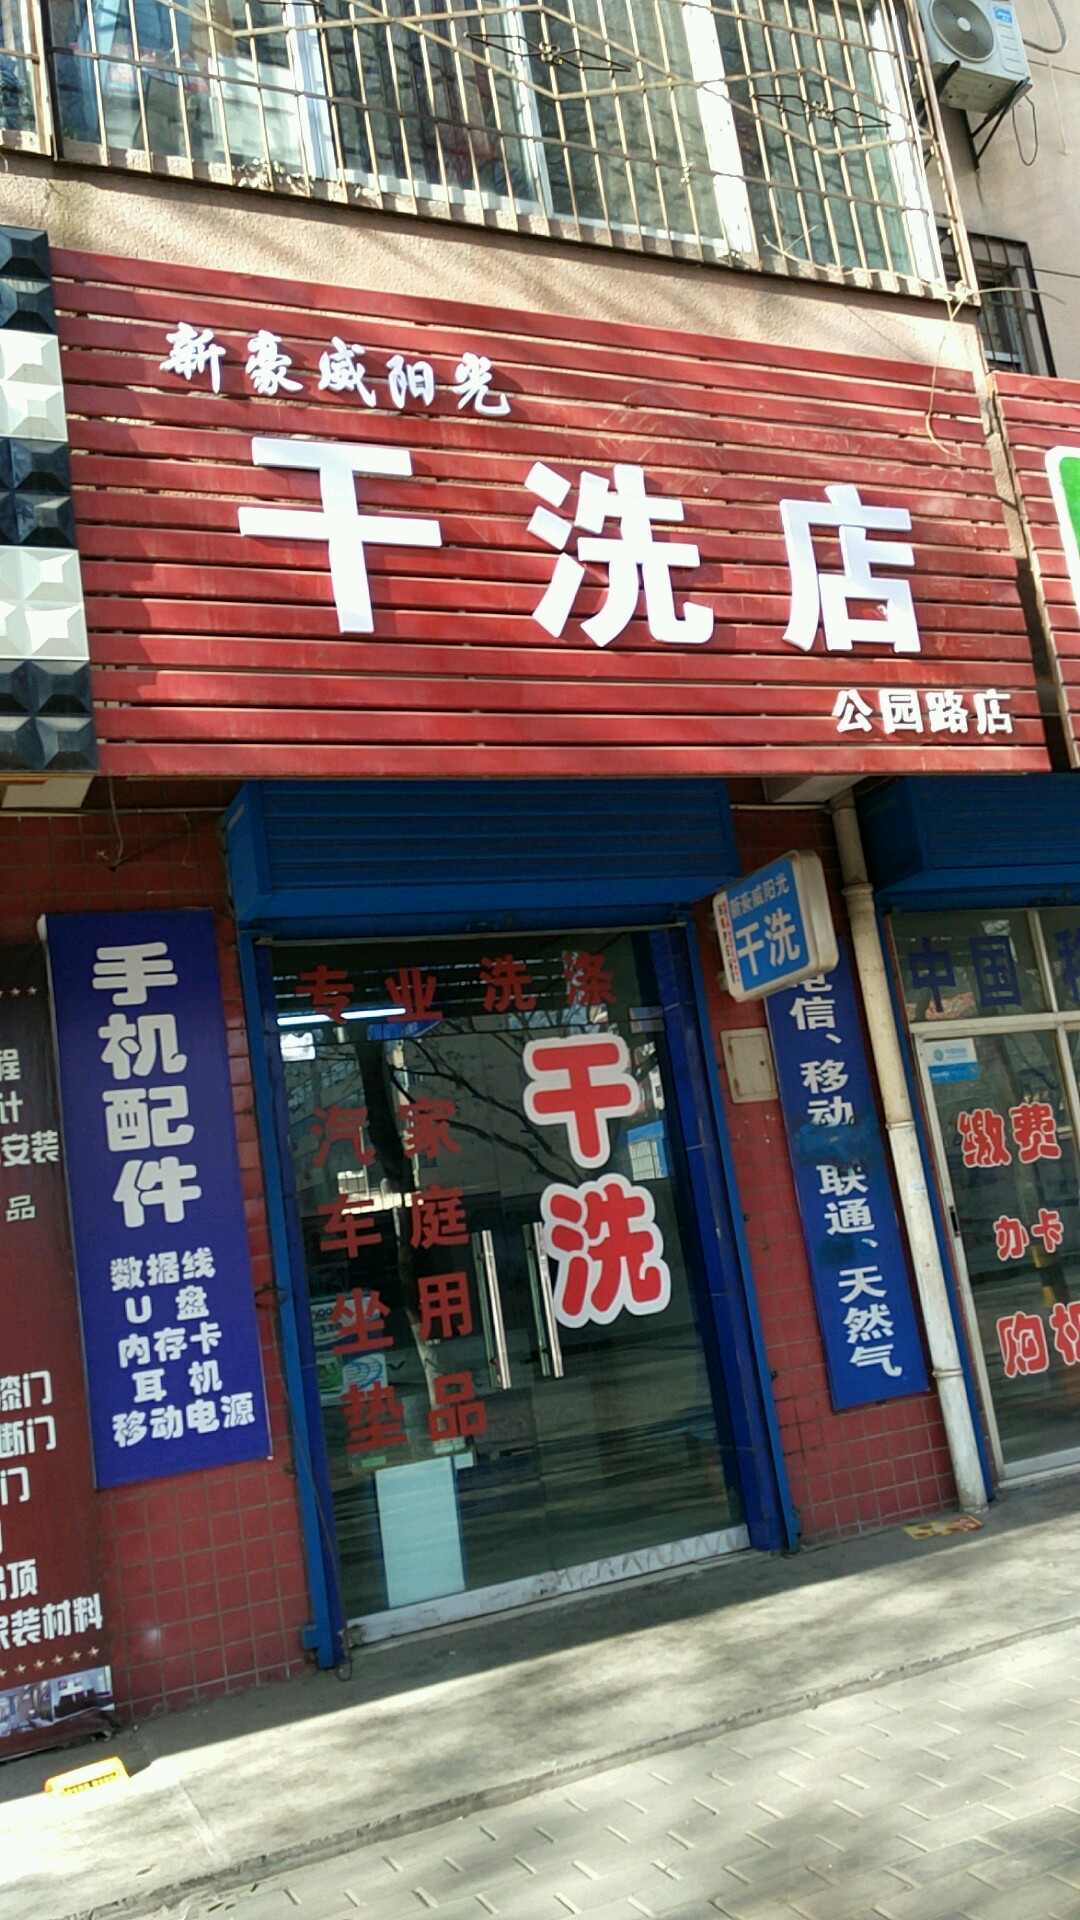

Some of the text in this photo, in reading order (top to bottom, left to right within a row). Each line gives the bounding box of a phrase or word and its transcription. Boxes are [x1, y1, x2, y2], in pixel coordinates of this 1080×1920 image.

[238, 437, 921, 652] 干洗店
[833, 688, 1013, 735] 公园路店
[735, 907, 801, 976] 干洗
[296, 950, 617, 1025] 专业洗涤
[92, 942, 202, 1228] 手机配件
[1, 1129, 60, 1167] 安装
[957, 1102, 1062, 1168] 缴费
[6, 1195, 36, 1222] 品
[523, 1034, 672, 1329] 干洗
[993, 1208, 1064, 1261] 办卡
[110, 1247, 216, 1291] 数据线
[308, 1106, 408, 1454] 汽车坐垫
[400, 1097, 488, 1441] 家庭用品
[118, 1321, 222, 1368] 内存卡
[131, 1360, 222, 1403] 耳机
[112, 1392, 255, 1448] 移动电源
[0, 1558, 38, 1601] 顶
